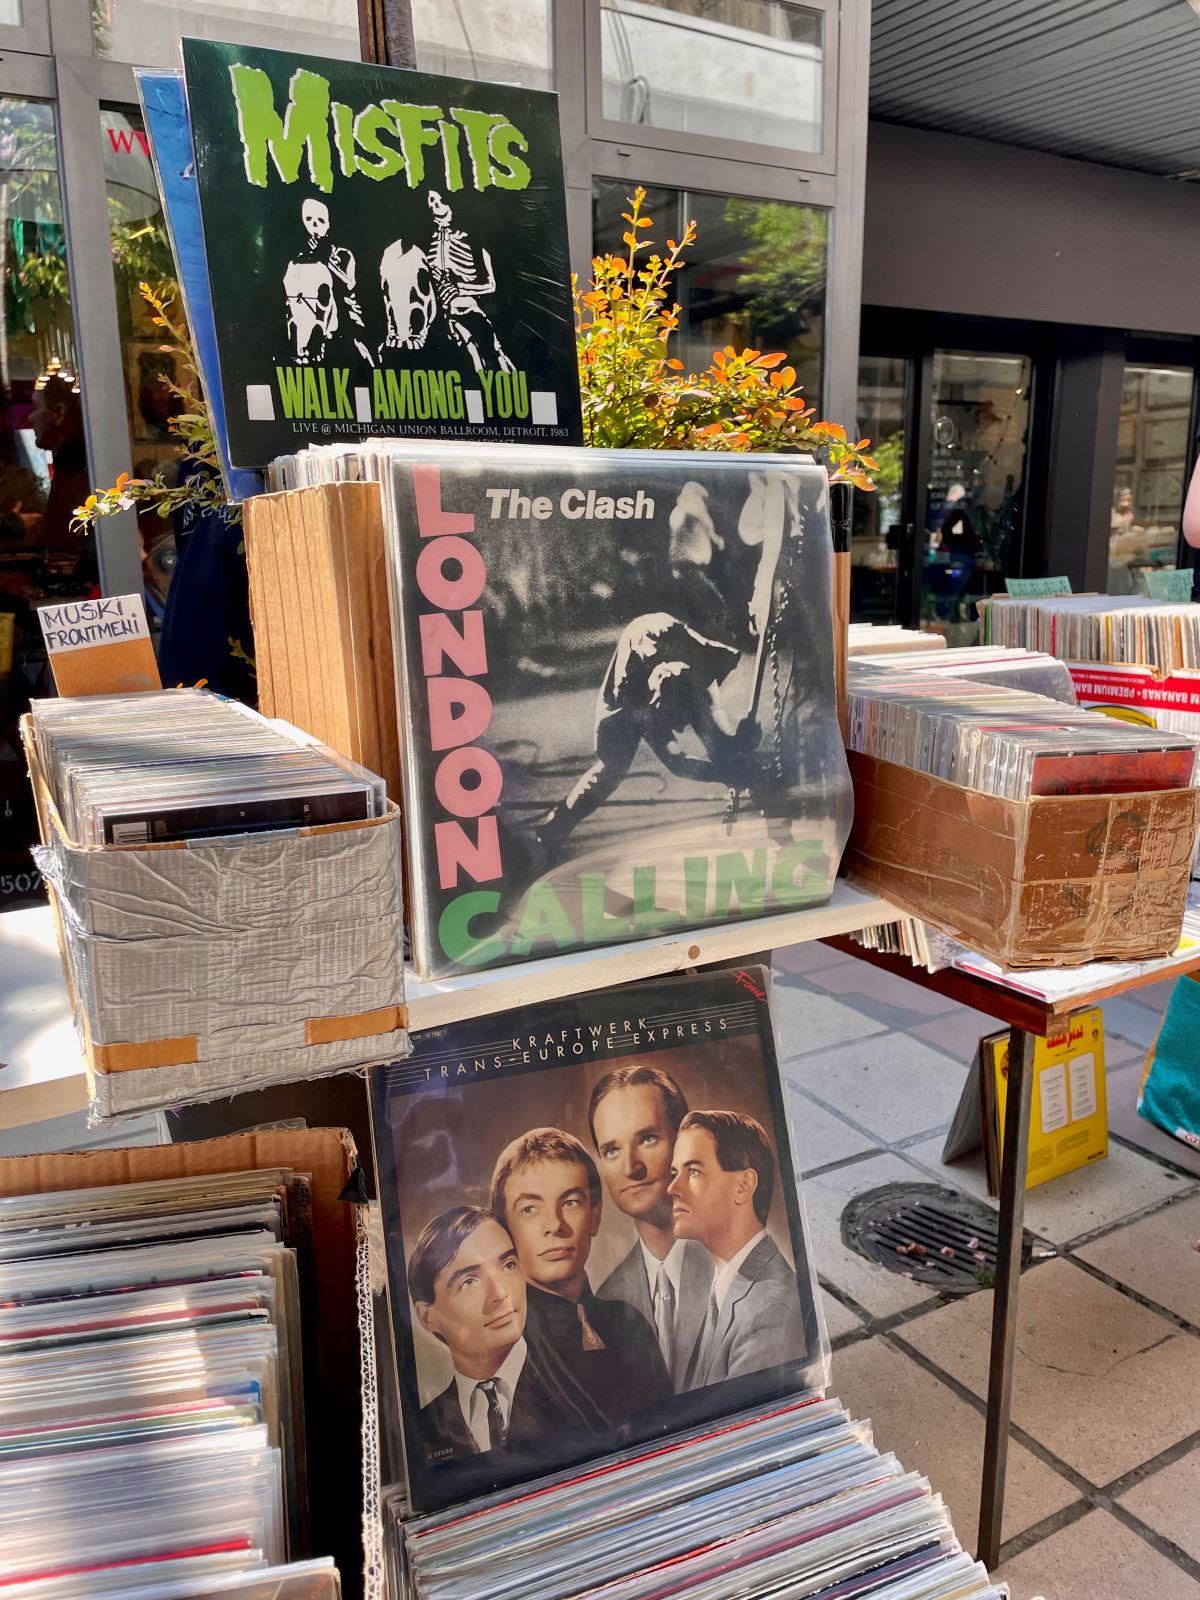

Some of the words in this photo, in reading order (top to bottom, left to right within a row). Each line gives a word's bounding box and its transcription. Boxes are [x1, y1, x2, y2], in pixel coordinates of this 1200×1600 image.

[229, 63, 531, 193] MISFITS
[276, 366, 354, 419] WALK
[373, 368, 465, 420] AMONG
[478, 369, 529, 419] YOU
[292, 422, 318, 433] LIVE
[321, 424, 332, 435] @
[335, 423, 395, 434] MICHIGAN
[399, 425, 437, 435] UNION
[440, 426, 501, 437] BALLROOM,
[550, 428, 569, 437] 1983
[485, 488, 553, 520] The
[560, 488, 655, 520] Clash
[412, 464, 503, 890] LONDON
[1093, 683, 1136, 697] PREMIUM
[1142, 687, 1188, 704] BANANAS
[439, 839, 828, 966] CALLING
[731, 969, 768, 1003] Fame
[424, 1037, 615, 1081] TRANS-EUROPE
[633, 1018, 728, 1045] EXPRESS
[512, 1017, 648, 1050] KRAFTWERK
